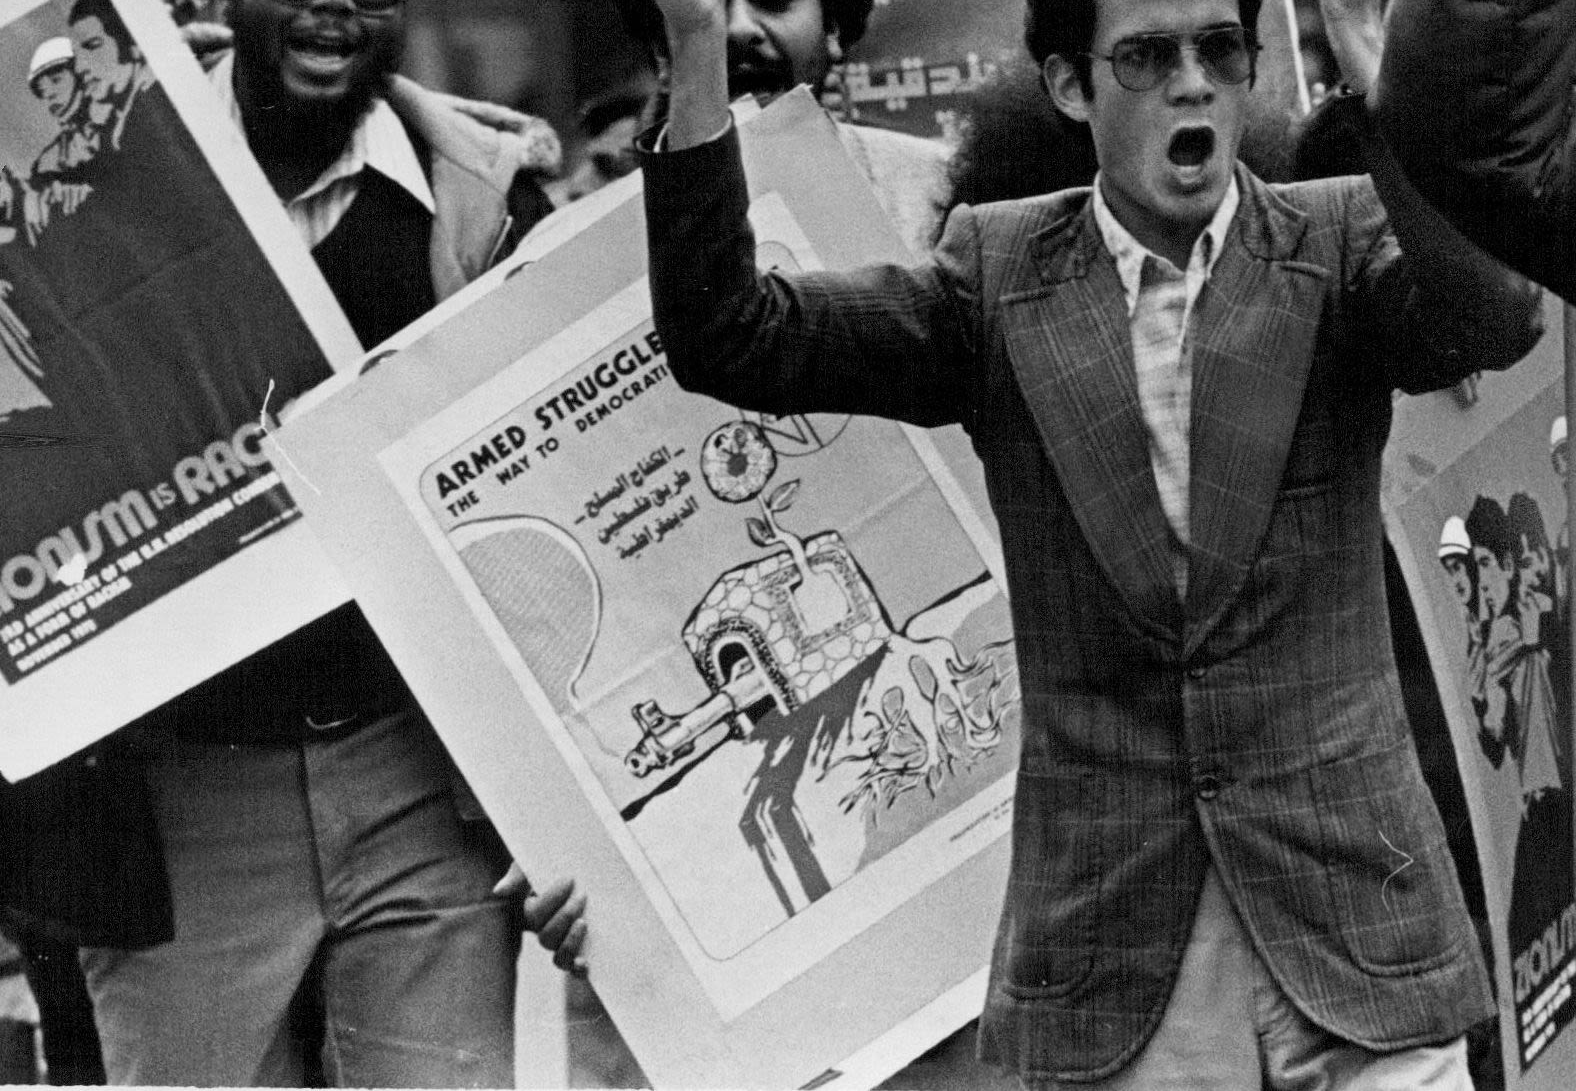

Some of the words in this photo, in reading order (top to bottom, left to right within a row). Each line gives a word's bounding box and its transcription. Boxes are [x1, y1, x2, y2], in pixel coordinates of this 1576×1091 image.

[435, 425, 527, 500] ARMED
[534, 330, 666, 431] STRUGGLE
[446, 491, 480, 517] THE
[495, 455, 531, 486] WAY
[535, 437, 560, 459] TO
[574, 364, 670, 434] DEMOCRATI
